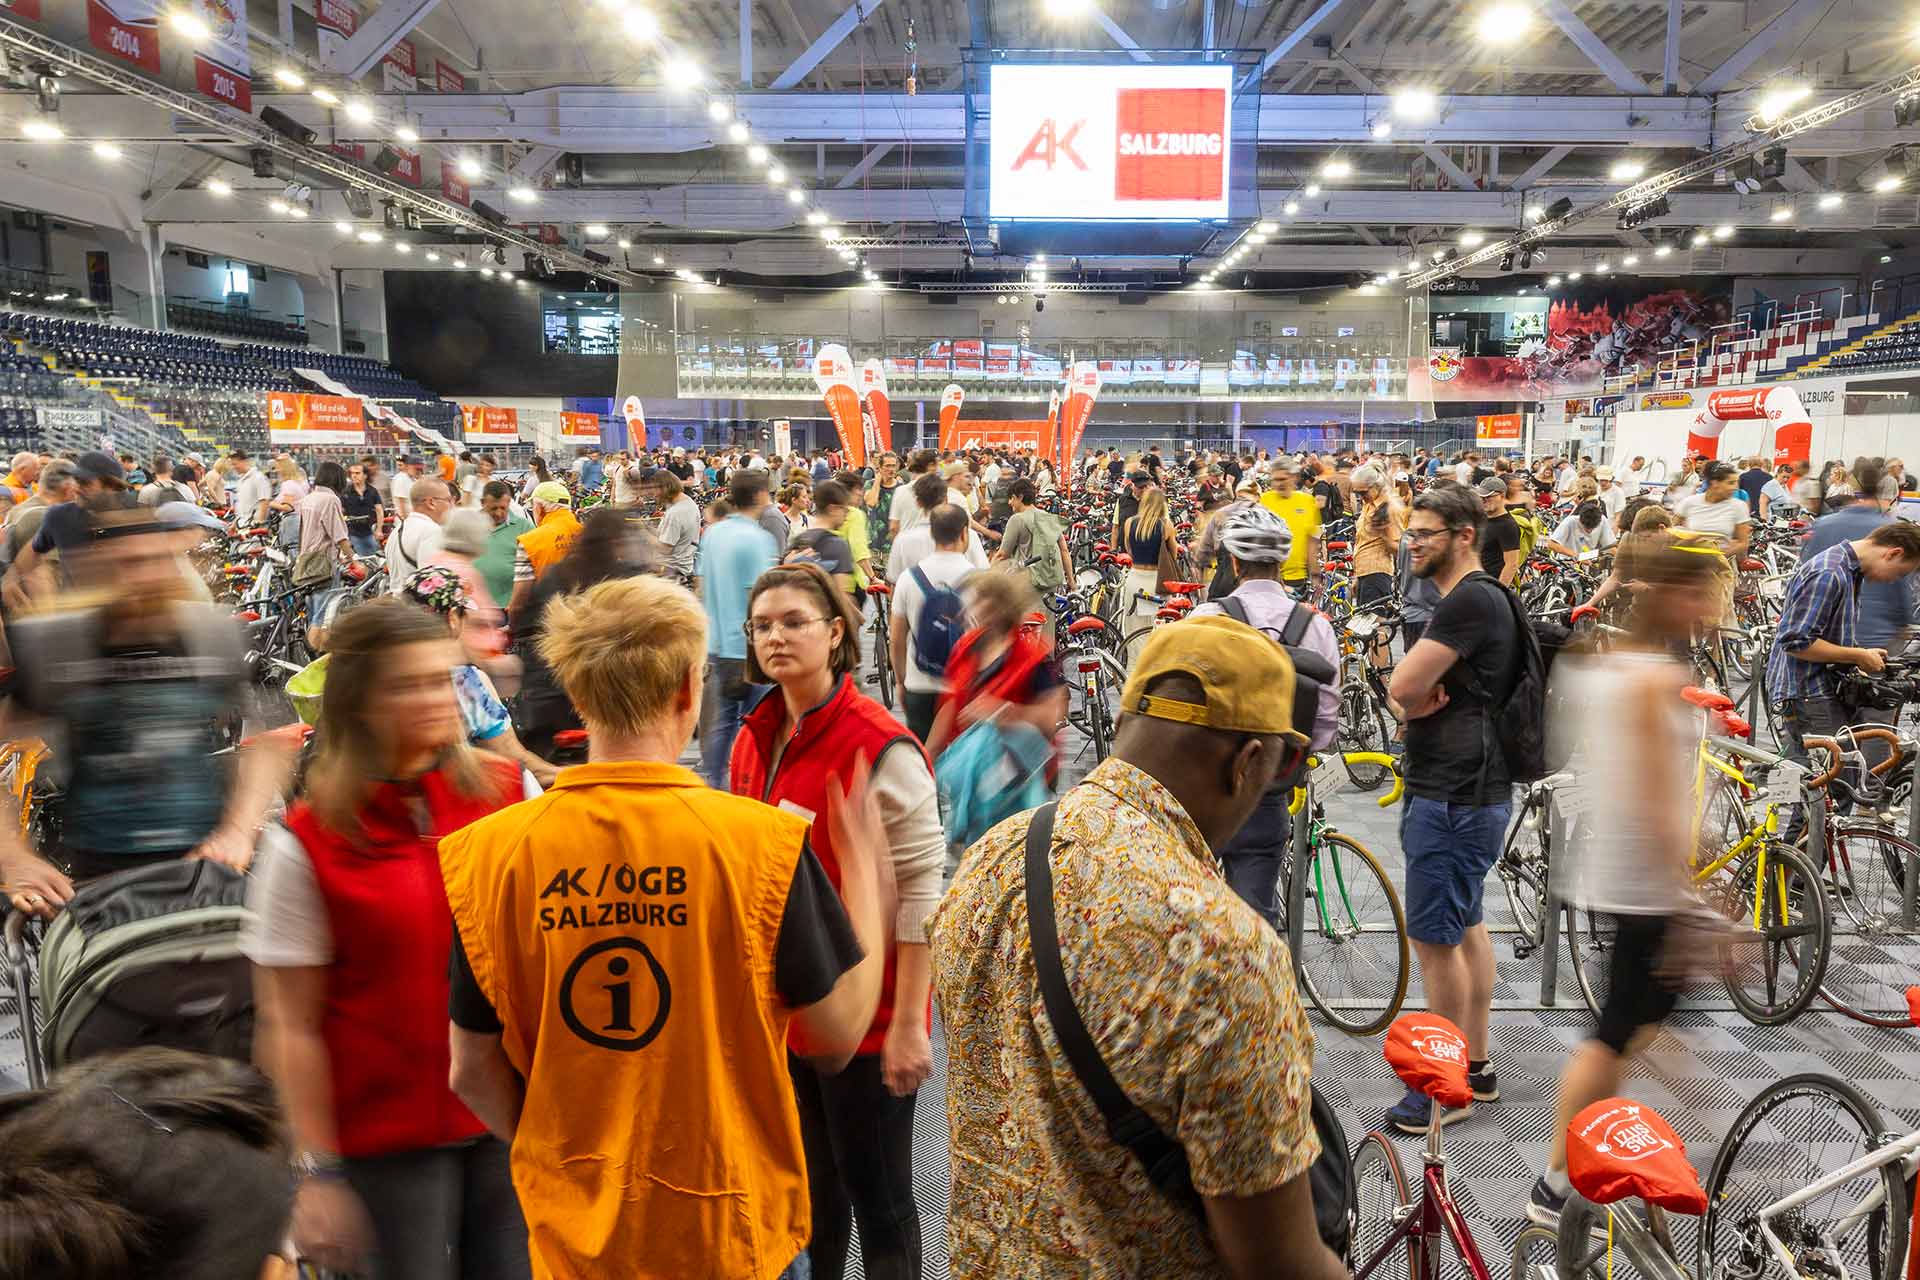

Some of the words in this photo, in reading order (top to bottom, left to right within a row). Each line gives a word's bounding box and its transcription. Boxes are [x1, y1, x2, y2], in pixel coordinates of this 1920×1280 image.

[110, 26, 140, 59] 2014
[213, 73, 237, 99] 2015
[1009, 117, 1089, 171] AK
[1119, 132, 1222, 156] SALZBURG
[539, 901, 688, 931] SALZBURG
[1612, 1123, 1651, 1148] SITZT
[1626, 1134, 1659, 1153] DAS
